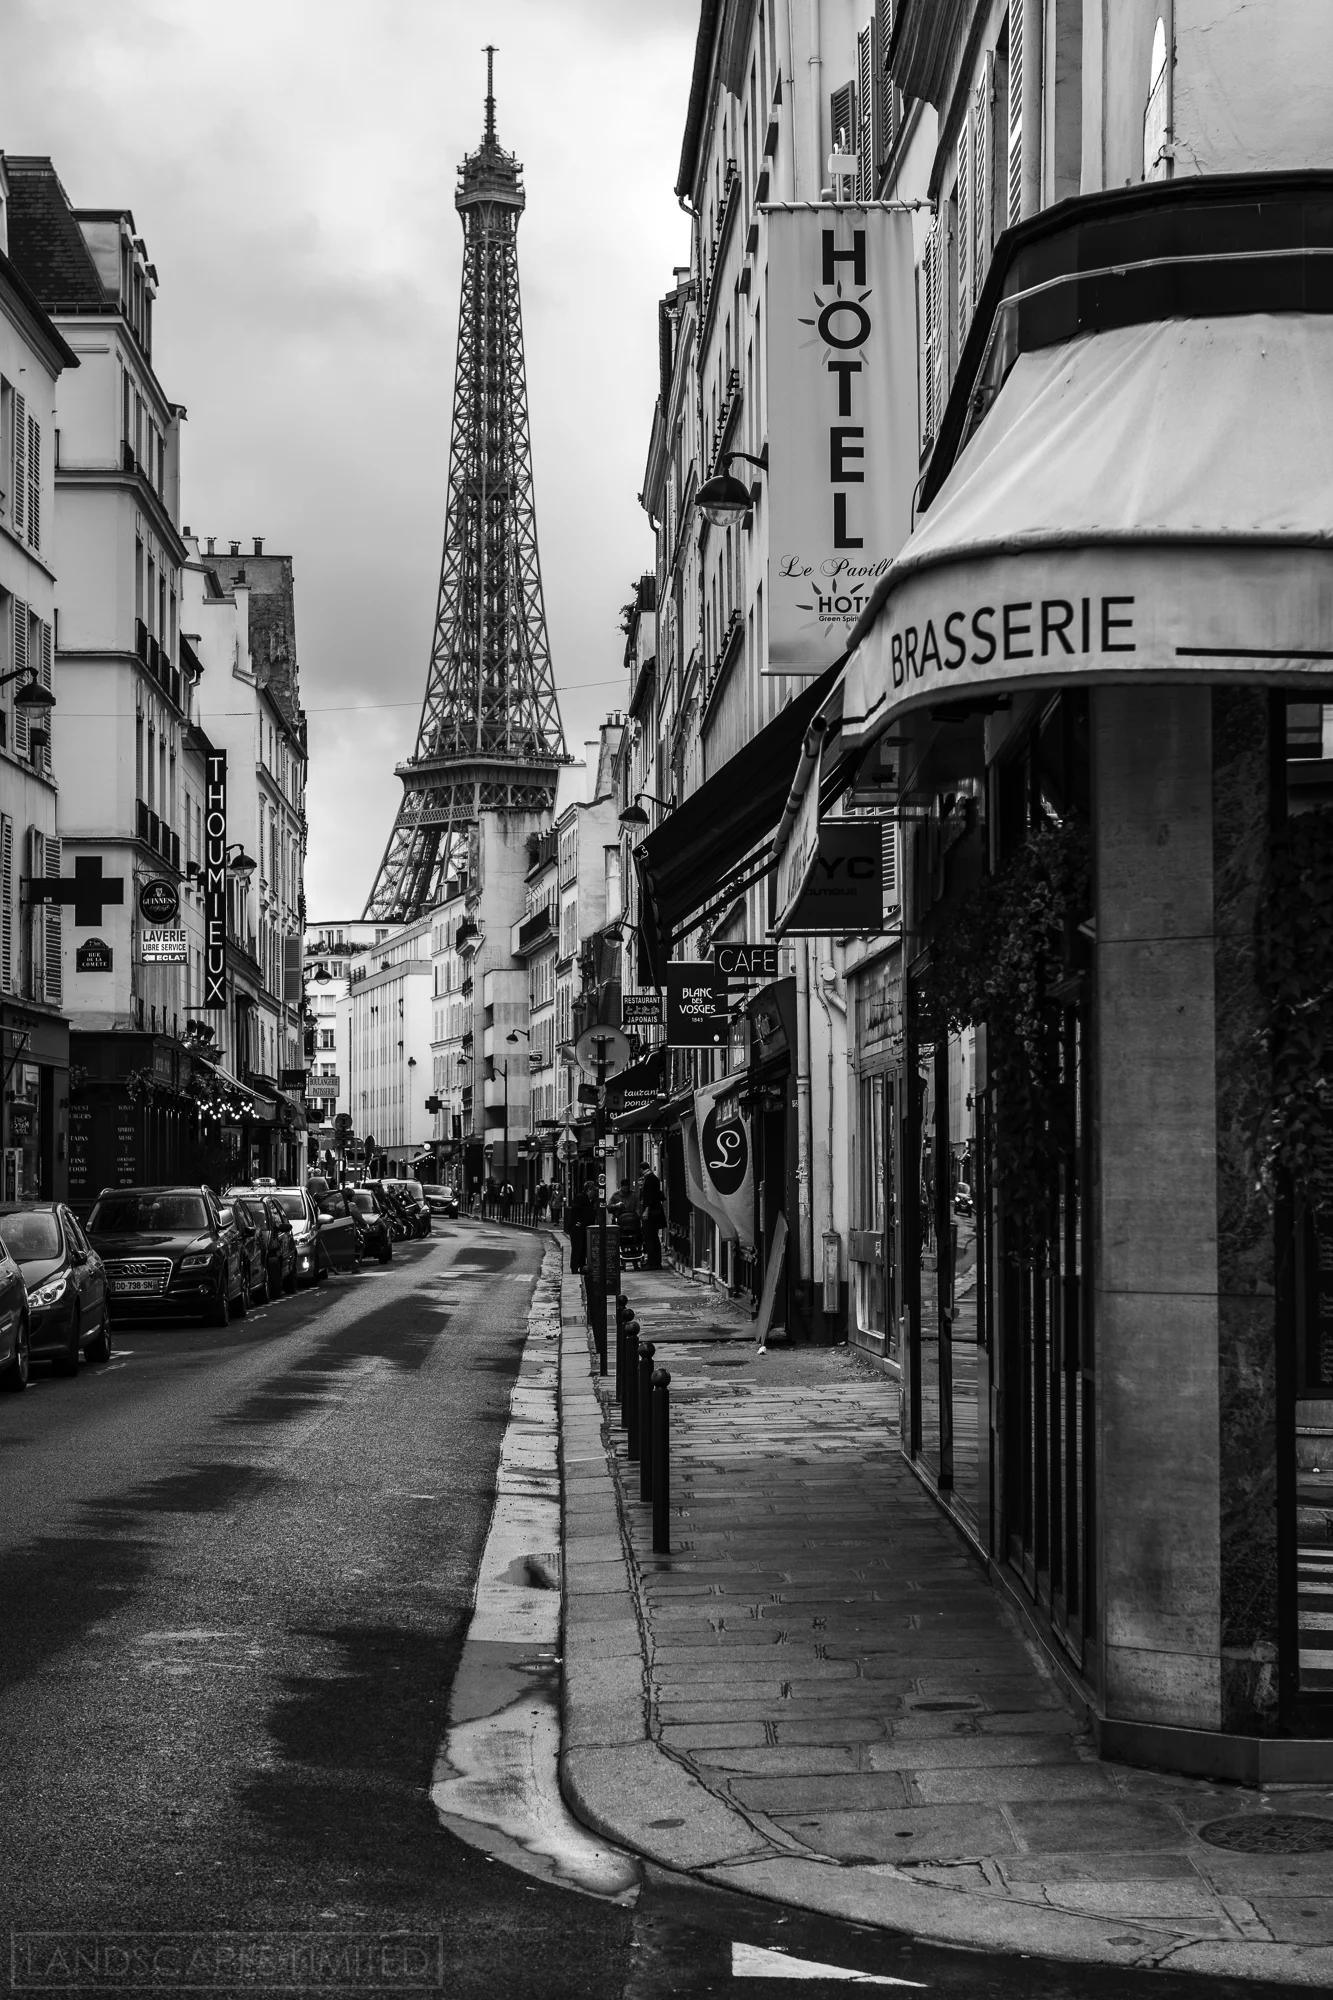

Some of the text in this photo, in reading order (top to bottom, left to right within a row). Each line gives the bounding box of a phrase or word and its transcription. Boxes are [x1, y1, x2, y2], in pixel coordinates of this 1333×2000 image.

[818, 230, 872, 549] HOTEL
[779, 555, 895, 578] Le Pavill
[819, 597, 870, 613] HOT
[891, 596, 1136, 689] BRASSERIE
[818, 857, 875, 879] YC
[207, 757, 225, 1001] THOUMIEUX
[804, 888, 858, 896] OUTIQUE
[143, 897, 177, 905] GUINNESS
[143, 930, 186, 942] LAVERIE
[719, 949, 775, 972] CAFE
[683, 988, 713, 999] BLANC
[624, 996, 660, 1004] RESTAURANT
[679, 1004, 716, 1014] VOSGES
[309, 1078, 339, 1086] BOULANGERIE
[312, 1088, 335, 1096] PATISSERIE
[624, 1088, 659, 1097] taurant
[624, 1099, 655, 1108] ponais
